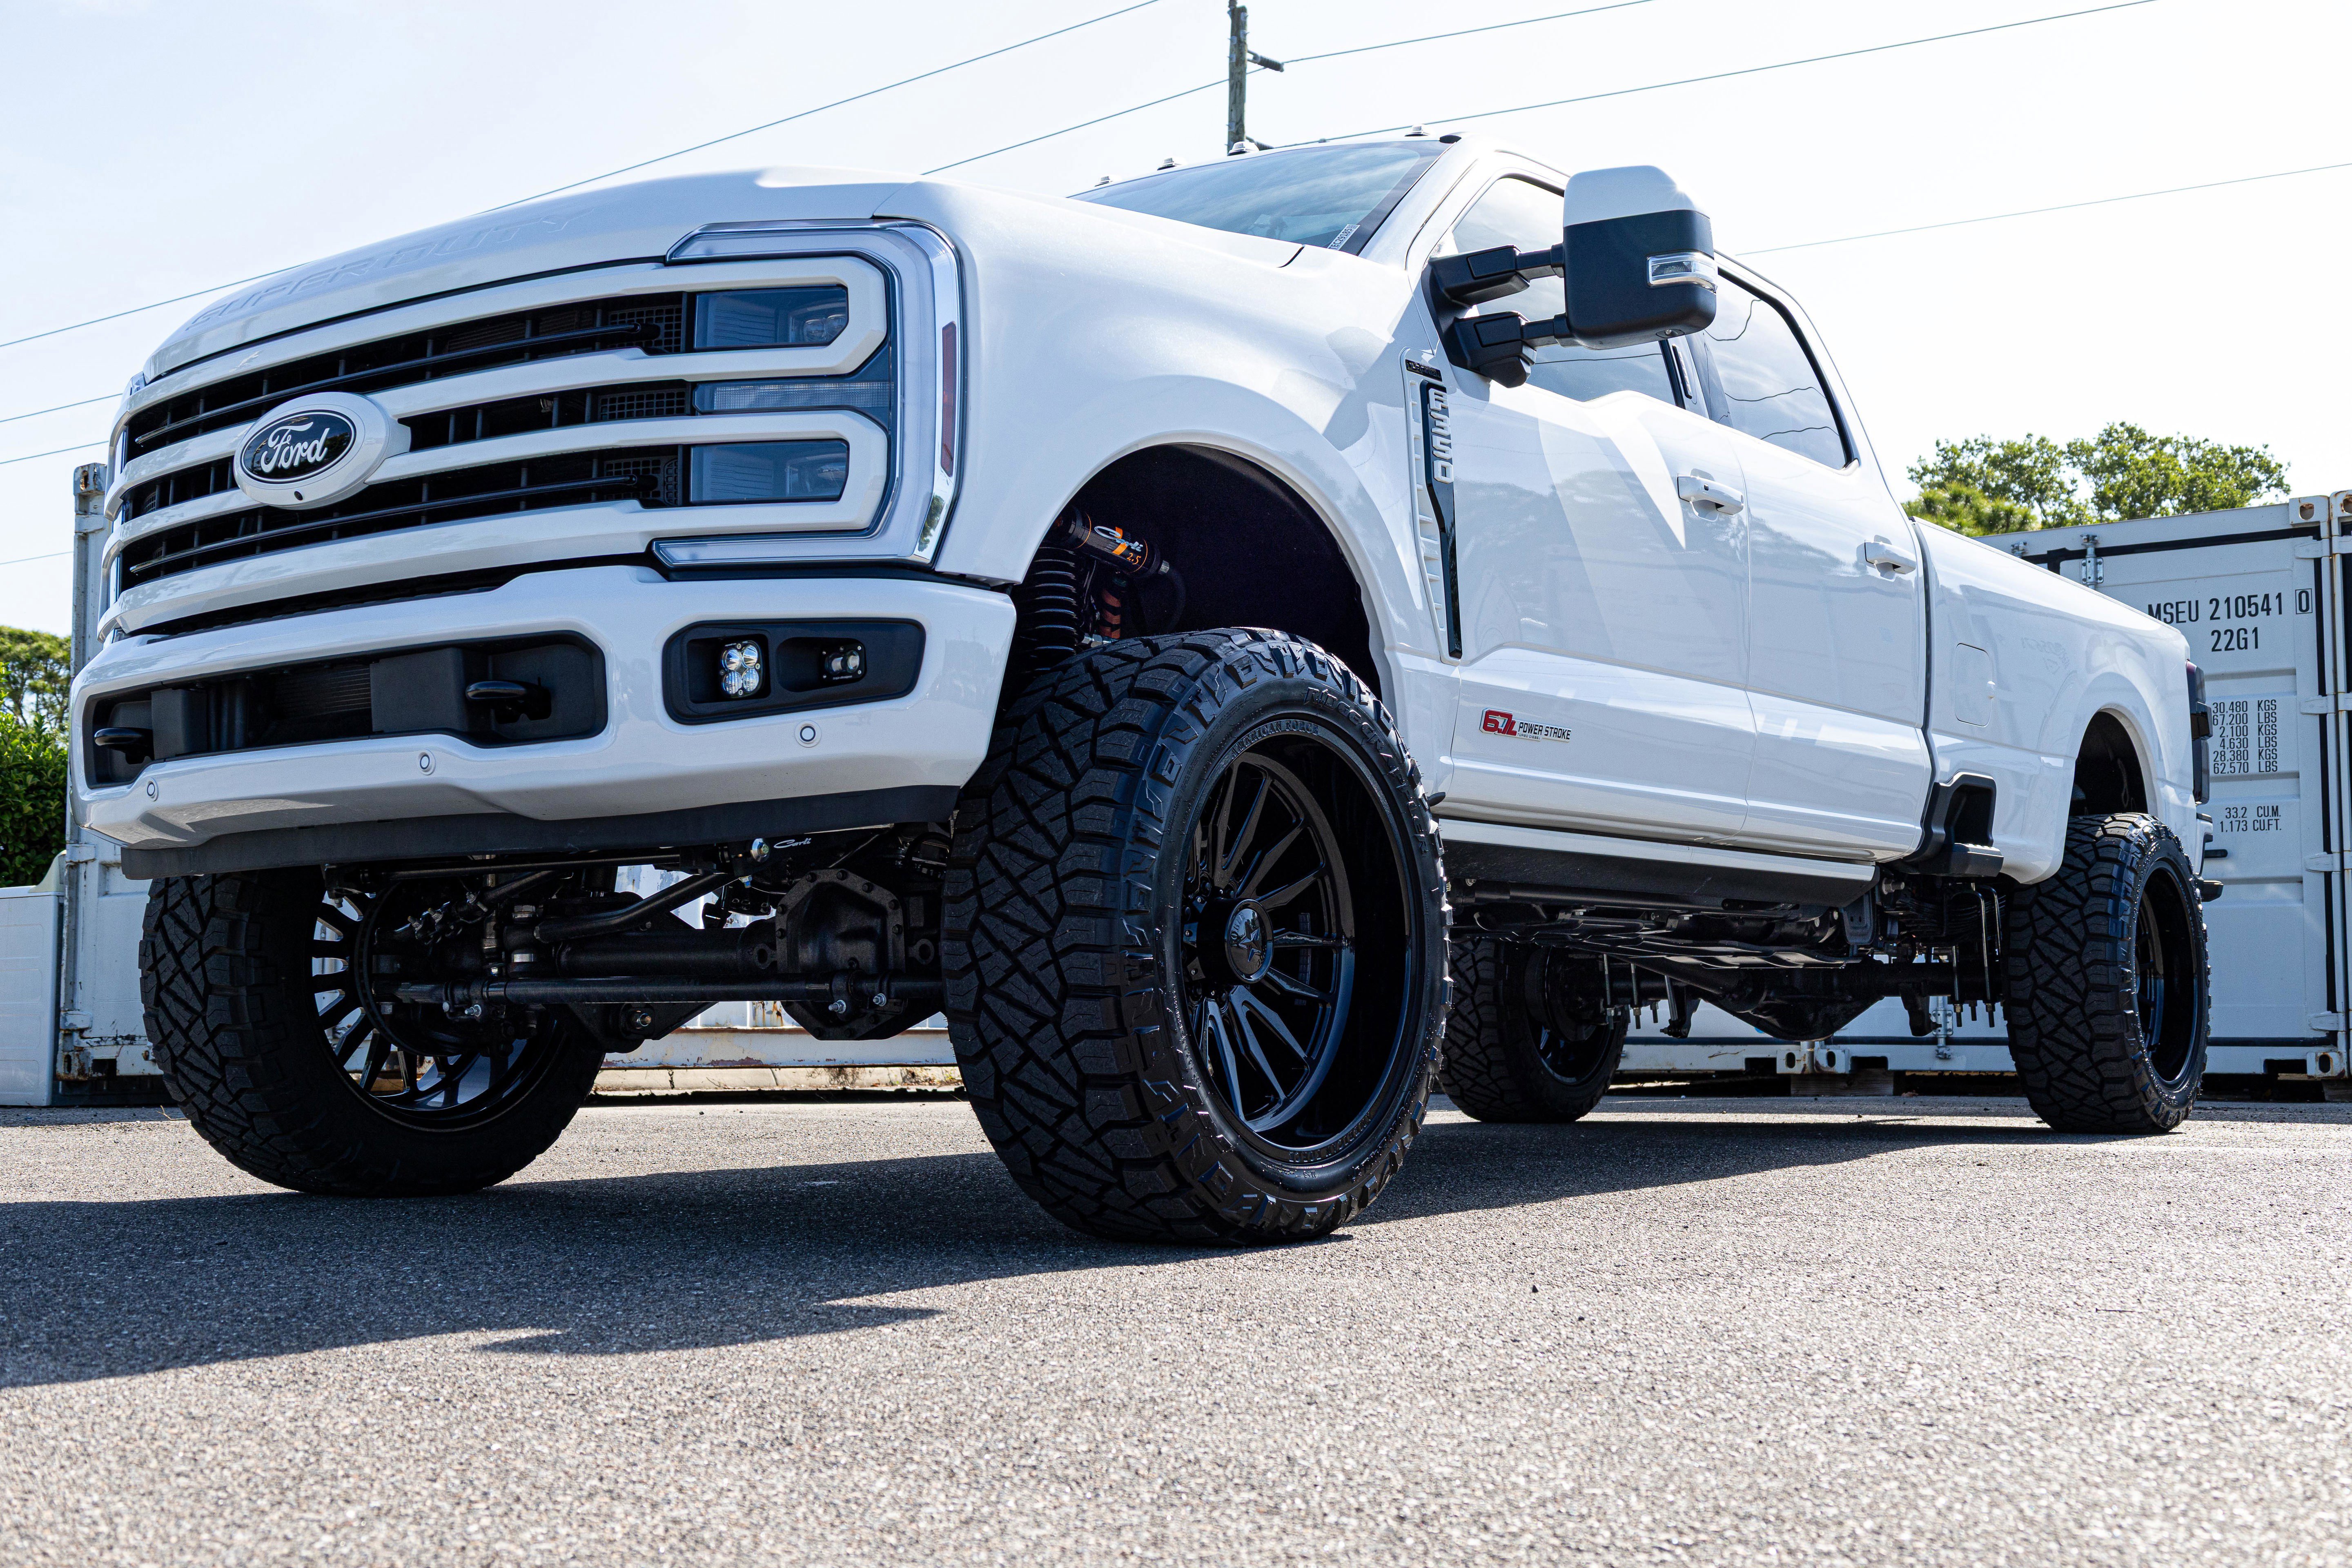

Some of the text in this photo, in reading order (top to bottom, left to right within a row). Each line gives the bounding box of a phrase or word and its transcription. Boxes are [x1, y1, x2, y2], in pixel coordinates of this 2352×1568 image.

[186, 207, 595, 330] SUPER DUTY
[260, 421, 330, 473] Ford
[1127, 552, 1141, 565] 2.5
[2148, 590, 2310, 624] MSEU 210541 0
[2211, 626, 2259, 652] 22G1
[2212, 699, 2277, 714] 30,480 KGS
[1483, 709, 1572, 740] 6.7L POWER STROKE
[2213, 712, 2277, 726] 67,200 LBS
[2220, 724, 2277, 737] 2,100 KGS
[1232, 719, 1319, 760] AMERICAN FORCE
[2220, 736, 2277, 750] 4,630 LBS
[2213, 748, 2278, 762] 28,380 KGS
[2214, 761, 2278, 774] 62,570 LBS
[2225, 806, 2281, 819] 33.2 CU.M.
[2220, 819, 2282, 833] 1,173 CU.FT.
[774, 838, 812, 849] Carli
